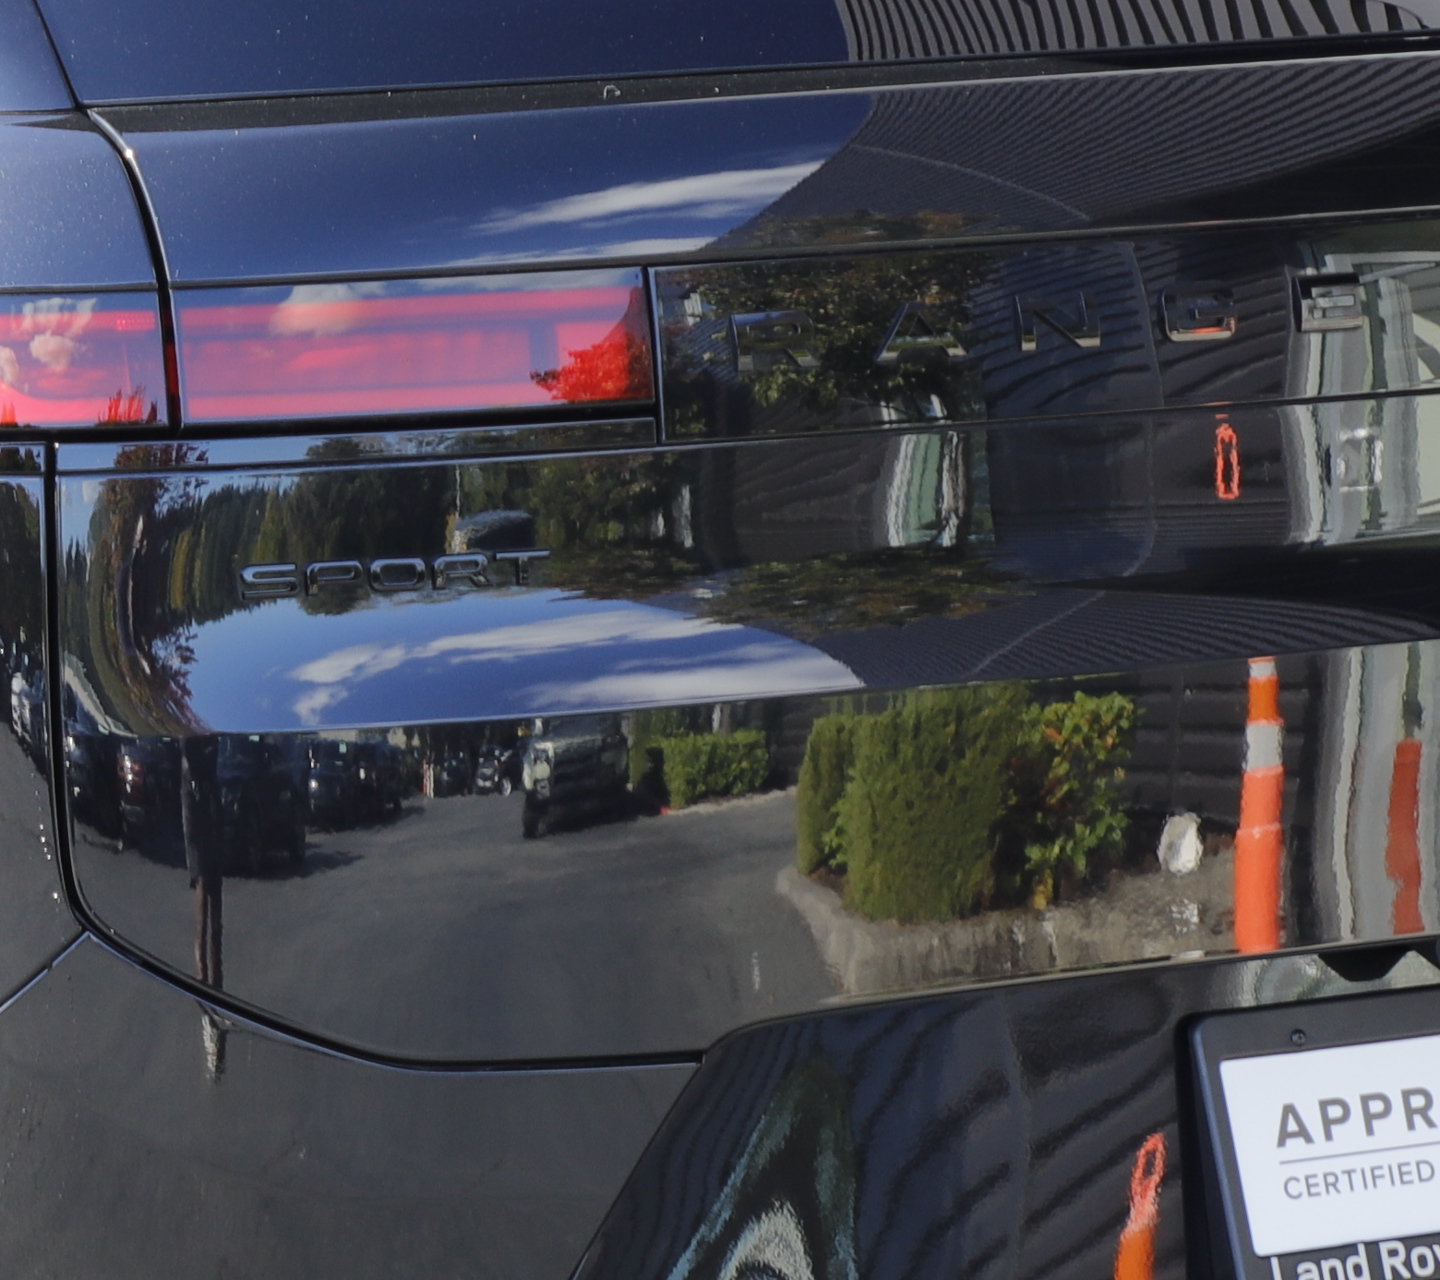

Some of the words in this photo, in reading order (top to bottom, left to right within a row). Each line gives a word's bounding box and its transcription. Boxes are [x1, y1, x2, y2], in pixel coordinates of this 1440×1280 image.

[727, 273, 1363, 375] RANGE
[240, 549, 550, 601] SPORT
[1283, 1157, 1436, 1201] CERTIFIED
